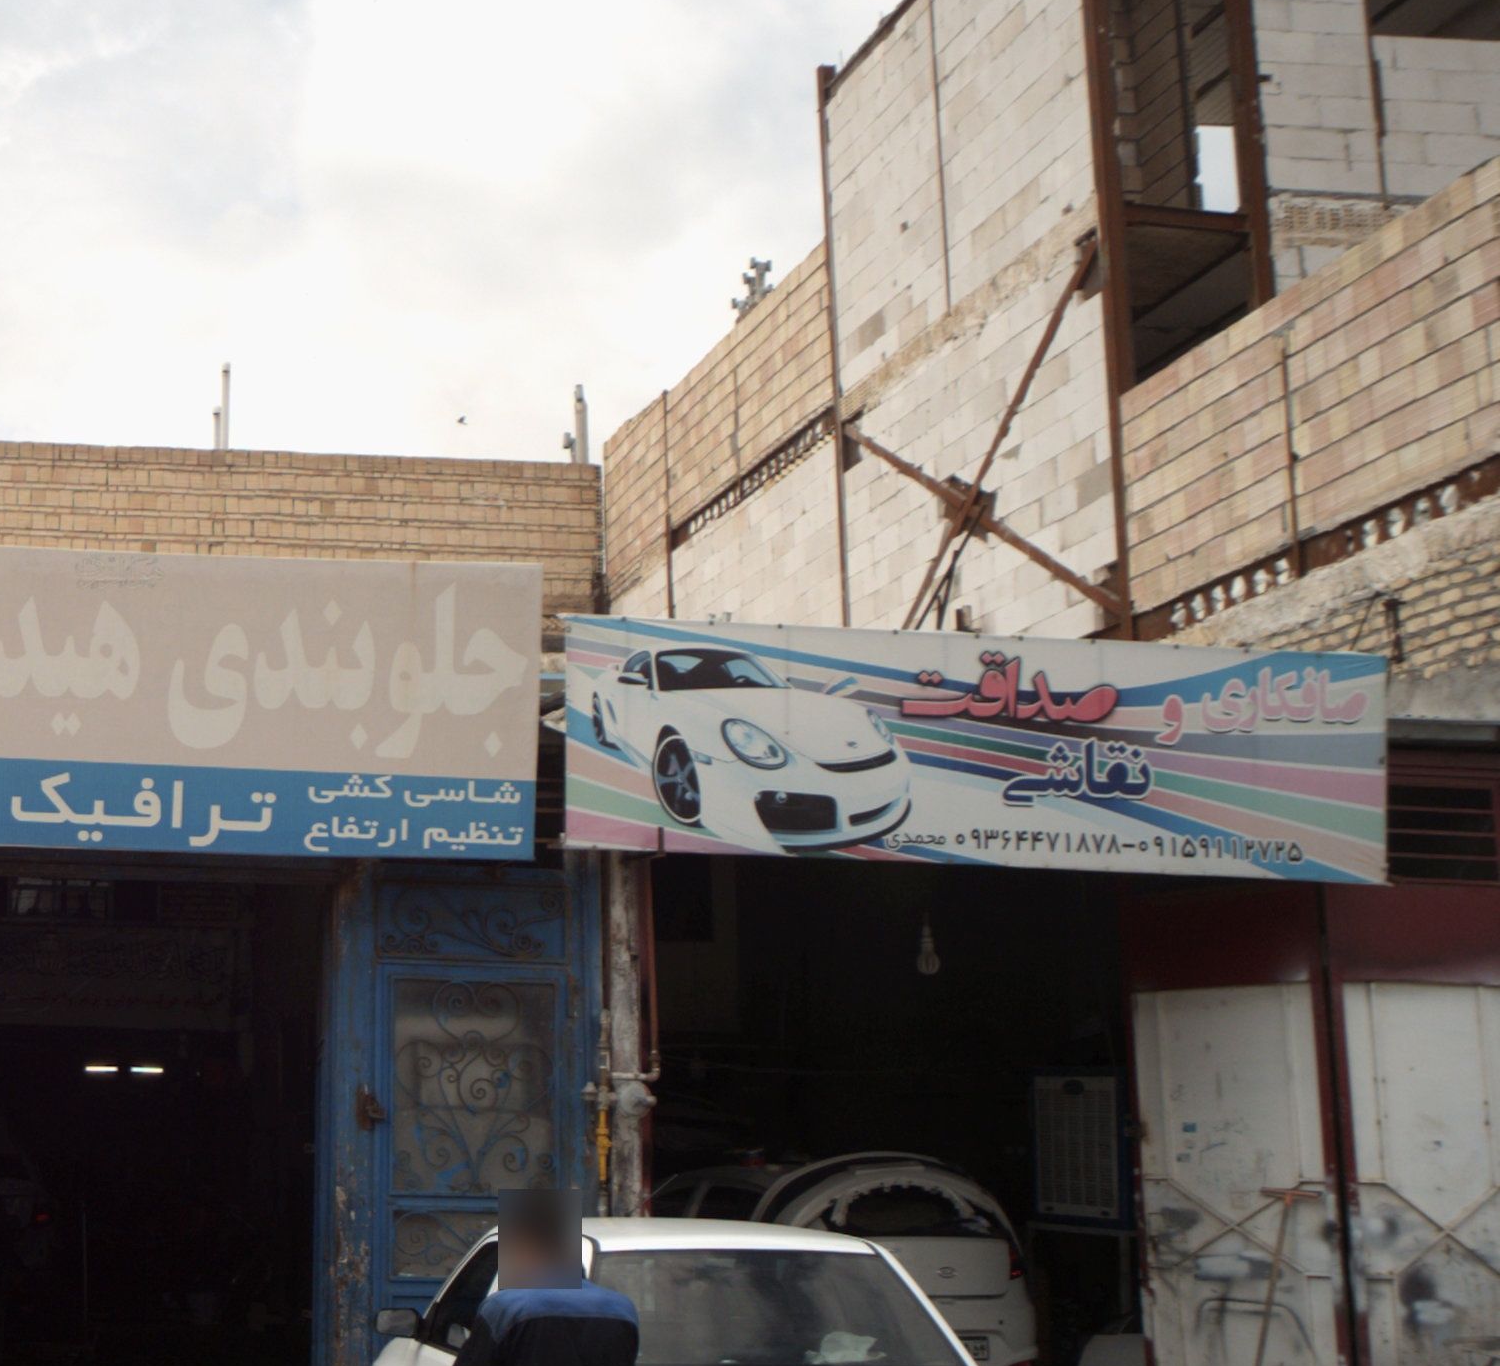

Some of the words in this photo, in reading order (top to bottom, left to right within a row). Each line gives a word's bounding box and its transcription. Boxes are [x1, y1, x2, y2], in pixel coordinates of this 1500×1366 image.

[167, 583, 528, 758] جلوبندی
[901, 651, 1119, 722] صداقت
[1156, 694, 1184, 745] و
[1202, 667, 1371, 733] صافکاری
[9, 771, 277, 847] ترافیک
[308, 774, 393, 804] کشی
[403, 776, 522, 807] شاسی
[303, 816, 409, 852] ارتفاع
[422, 821, 524, 850] تنظیم
[886, 832, 947, 851] محمدی
